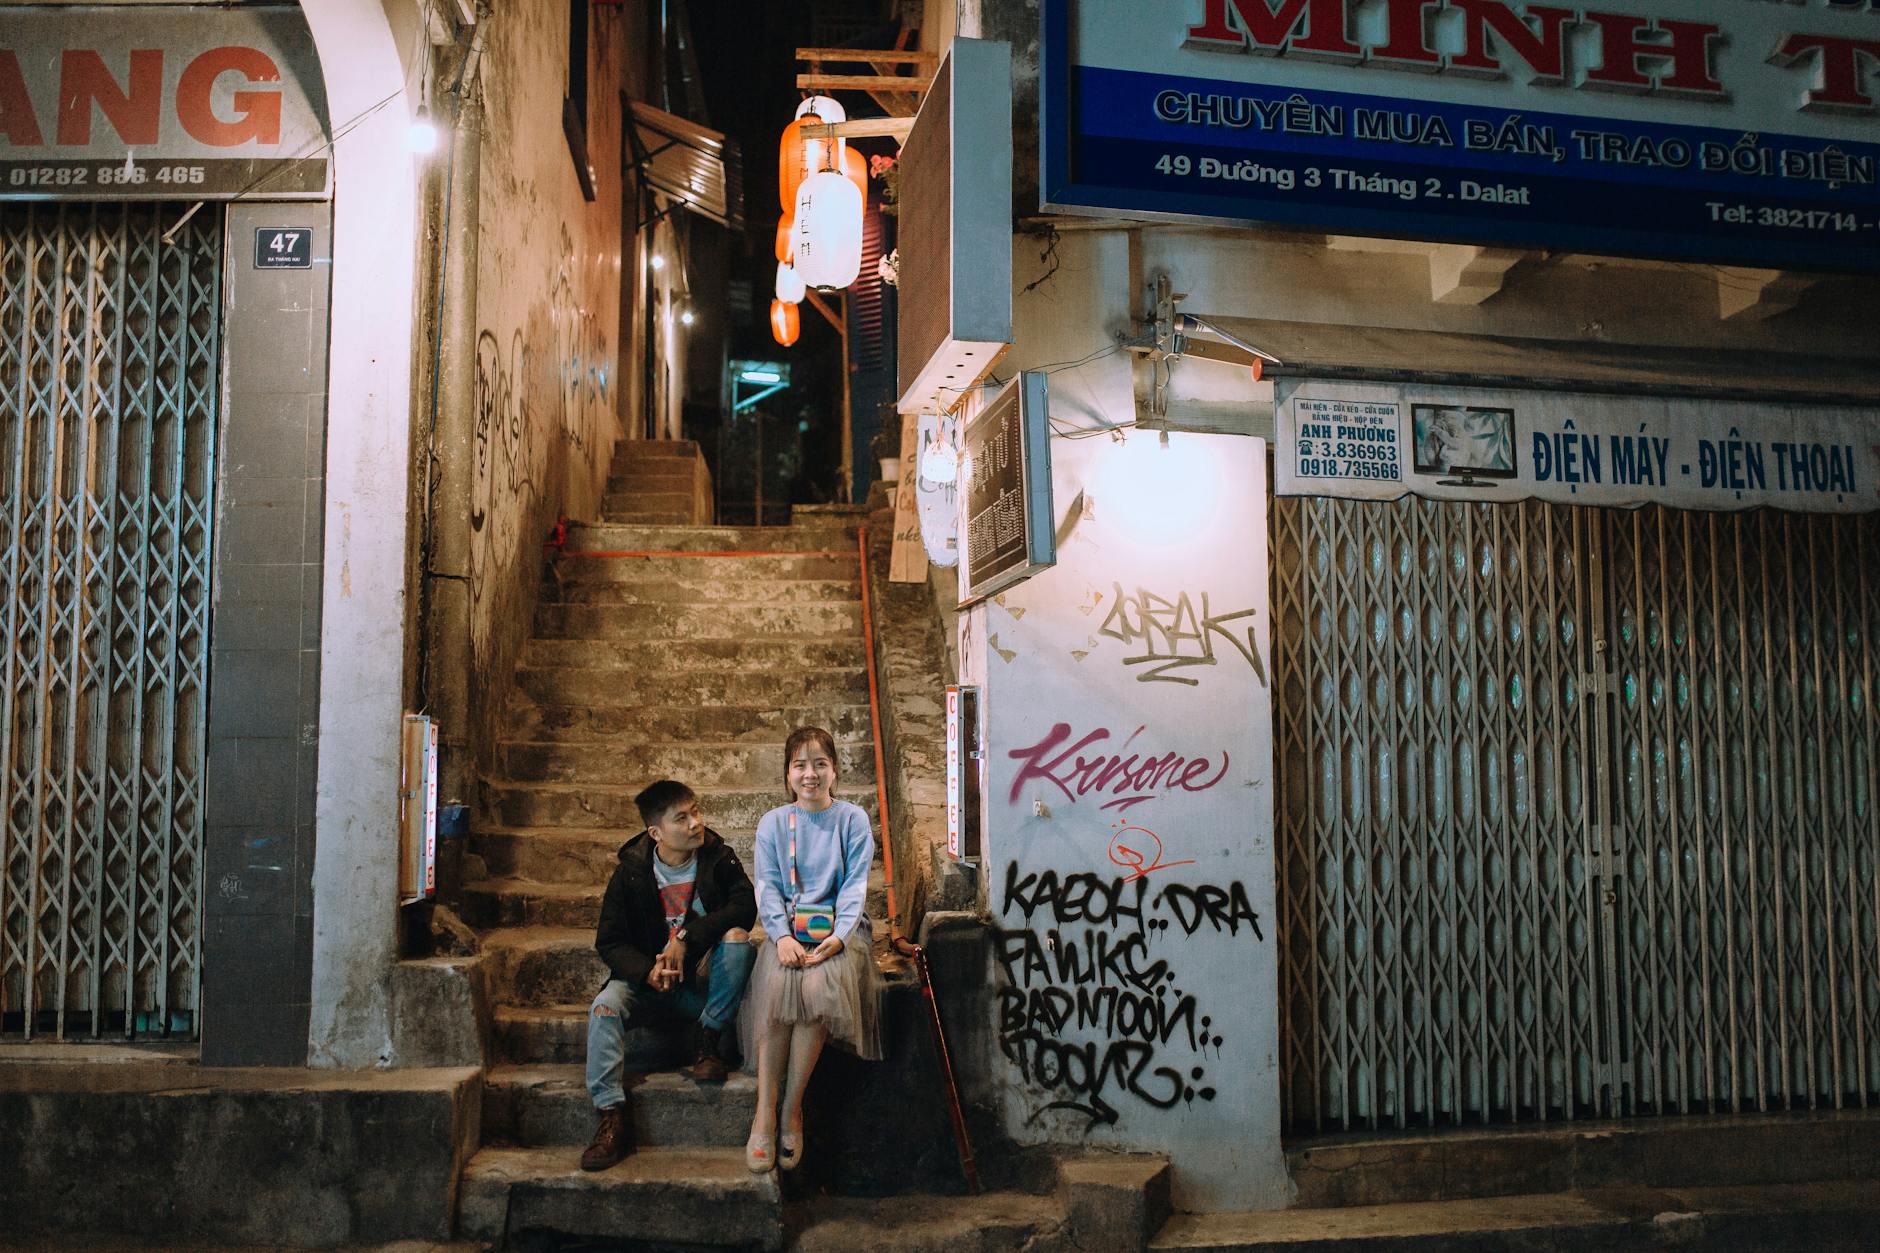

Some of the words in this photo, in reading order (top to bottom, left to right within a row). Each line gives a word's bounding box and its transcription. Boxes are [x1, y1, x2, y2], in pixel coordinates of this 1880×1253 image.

[1186, 0, 1723, 93] MINH
[1153, 89, 1344, 136] CHUYÊN
[1354, 108, 1453, 146] MUA
[1463, 115, 1566, 164] BÁN,
[1571, 130, 1691, 167] TRAO
[1701, 131, 1773, 176] ĐỔI
[1781, 145, 1874, 189] ĐIỆN
[10, 166, 88, 186] 01282
[155, 166, 205, 184] 465
[1155, 154, 1191, 176] 49
[1198, 157, 1295, 190] Đường
[1304, 167, 1322, 188] 3
[1328, 168, 1417, 201] Tháng
[1460, 180, 1530, 206] Dalat
[1757, 206, 1857, 232] 3821714
[270, 232, 300, 253] 47
[1301, 424, 1332, 439] ANH
[1300, 458, 1399, 479] 0918.735566
[1532, 419, 1601, 494] ĐIỆN
[1611, 423, 1669, 486] MÁY
[1699, 427, 1765, 499] ĐIỆN
[1772, 442, 1856, 503] THOẠI
[949, 695, 957, 851] COFFEE
